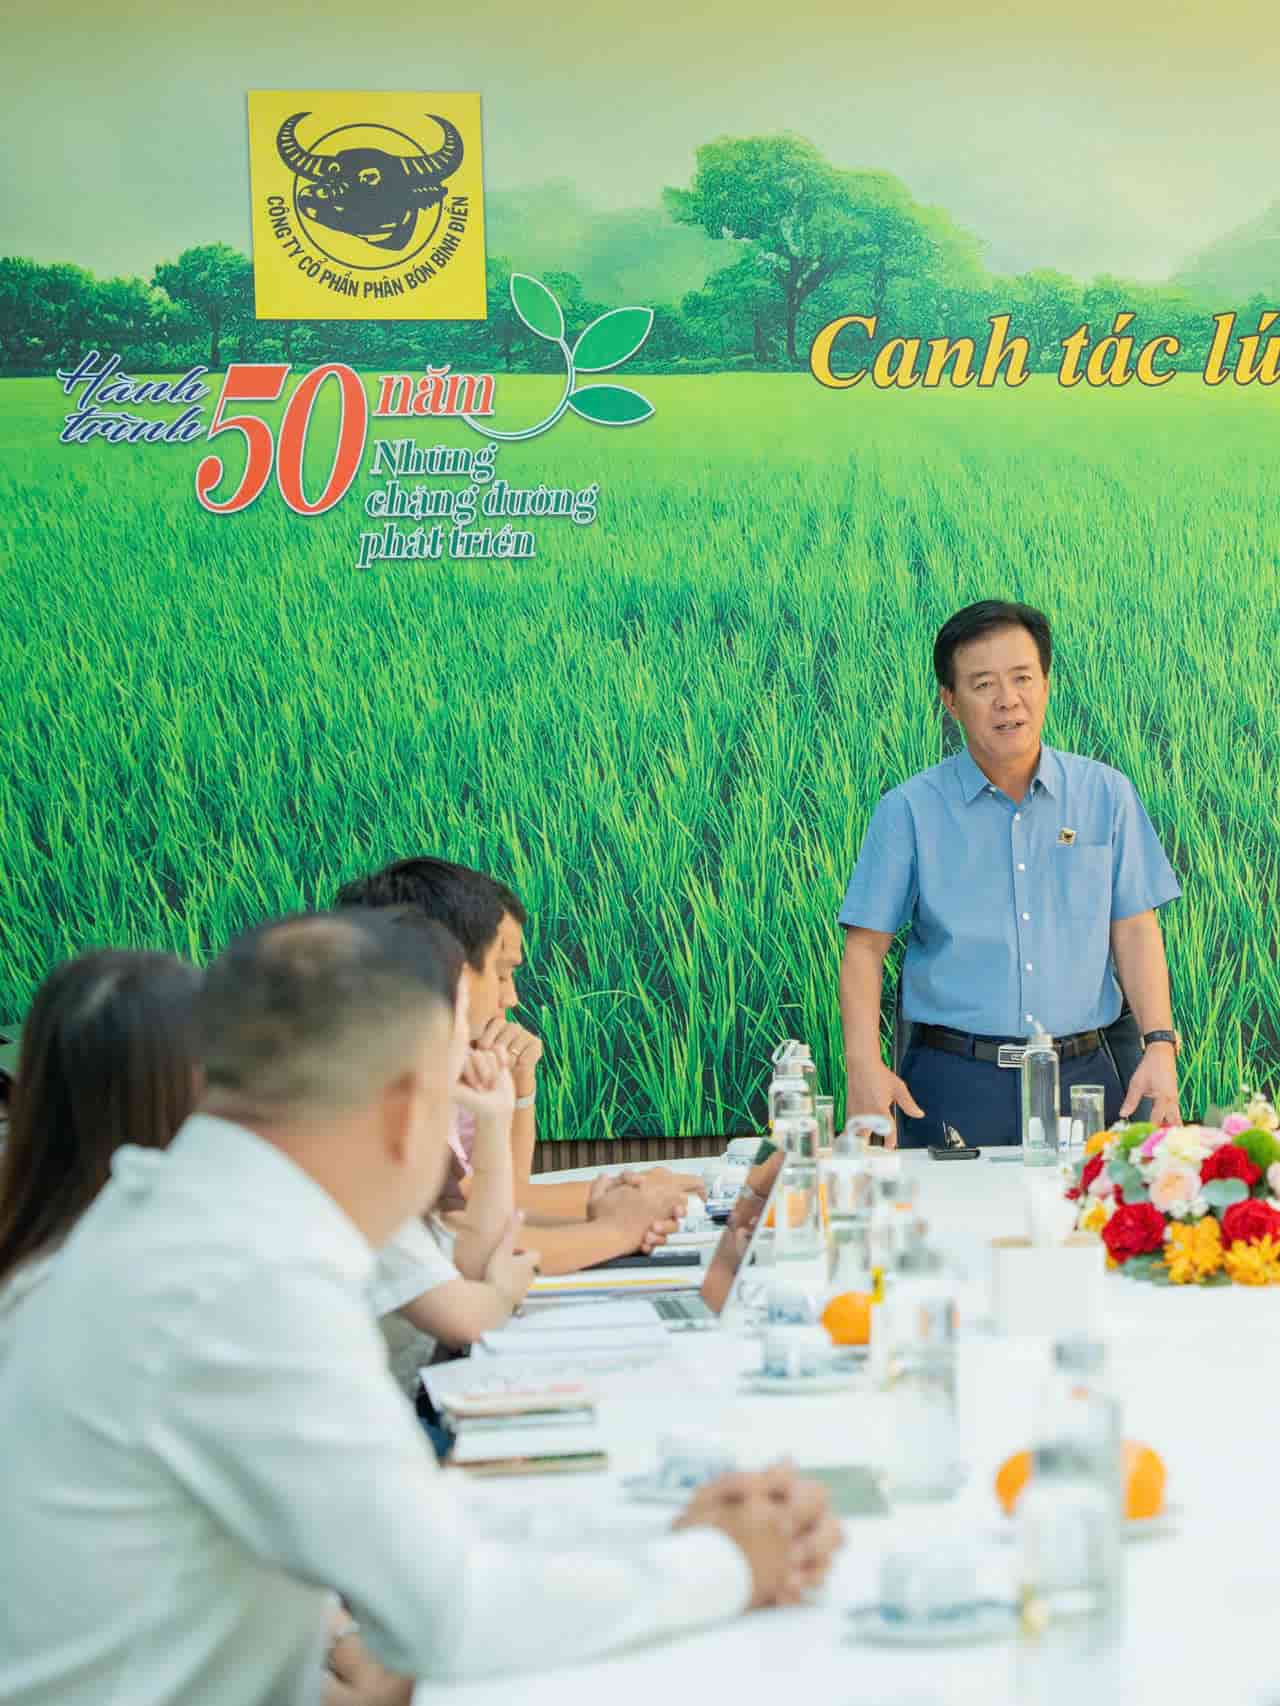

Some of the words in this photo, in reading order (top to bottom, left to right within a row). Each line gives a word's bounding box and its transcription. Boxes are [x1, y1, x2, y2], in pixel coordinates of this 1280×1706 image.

[267, 196, 292, 239] CÔNG
[282, 236, 304, 258] TY
[298, 255, 328, 278] CỔ
[430, 232, 461, 268] BÌNH
[56, 350, 210, 410] Hành
[808, 313, 1031, 389] Canh
[1058, 311, 1180, 388] tác
[60, 405, 207, 443] trình
[195, 363, 367, 515] 50
[373, 364, 495, 416] năm
[355, 522, 445, 569] phát
